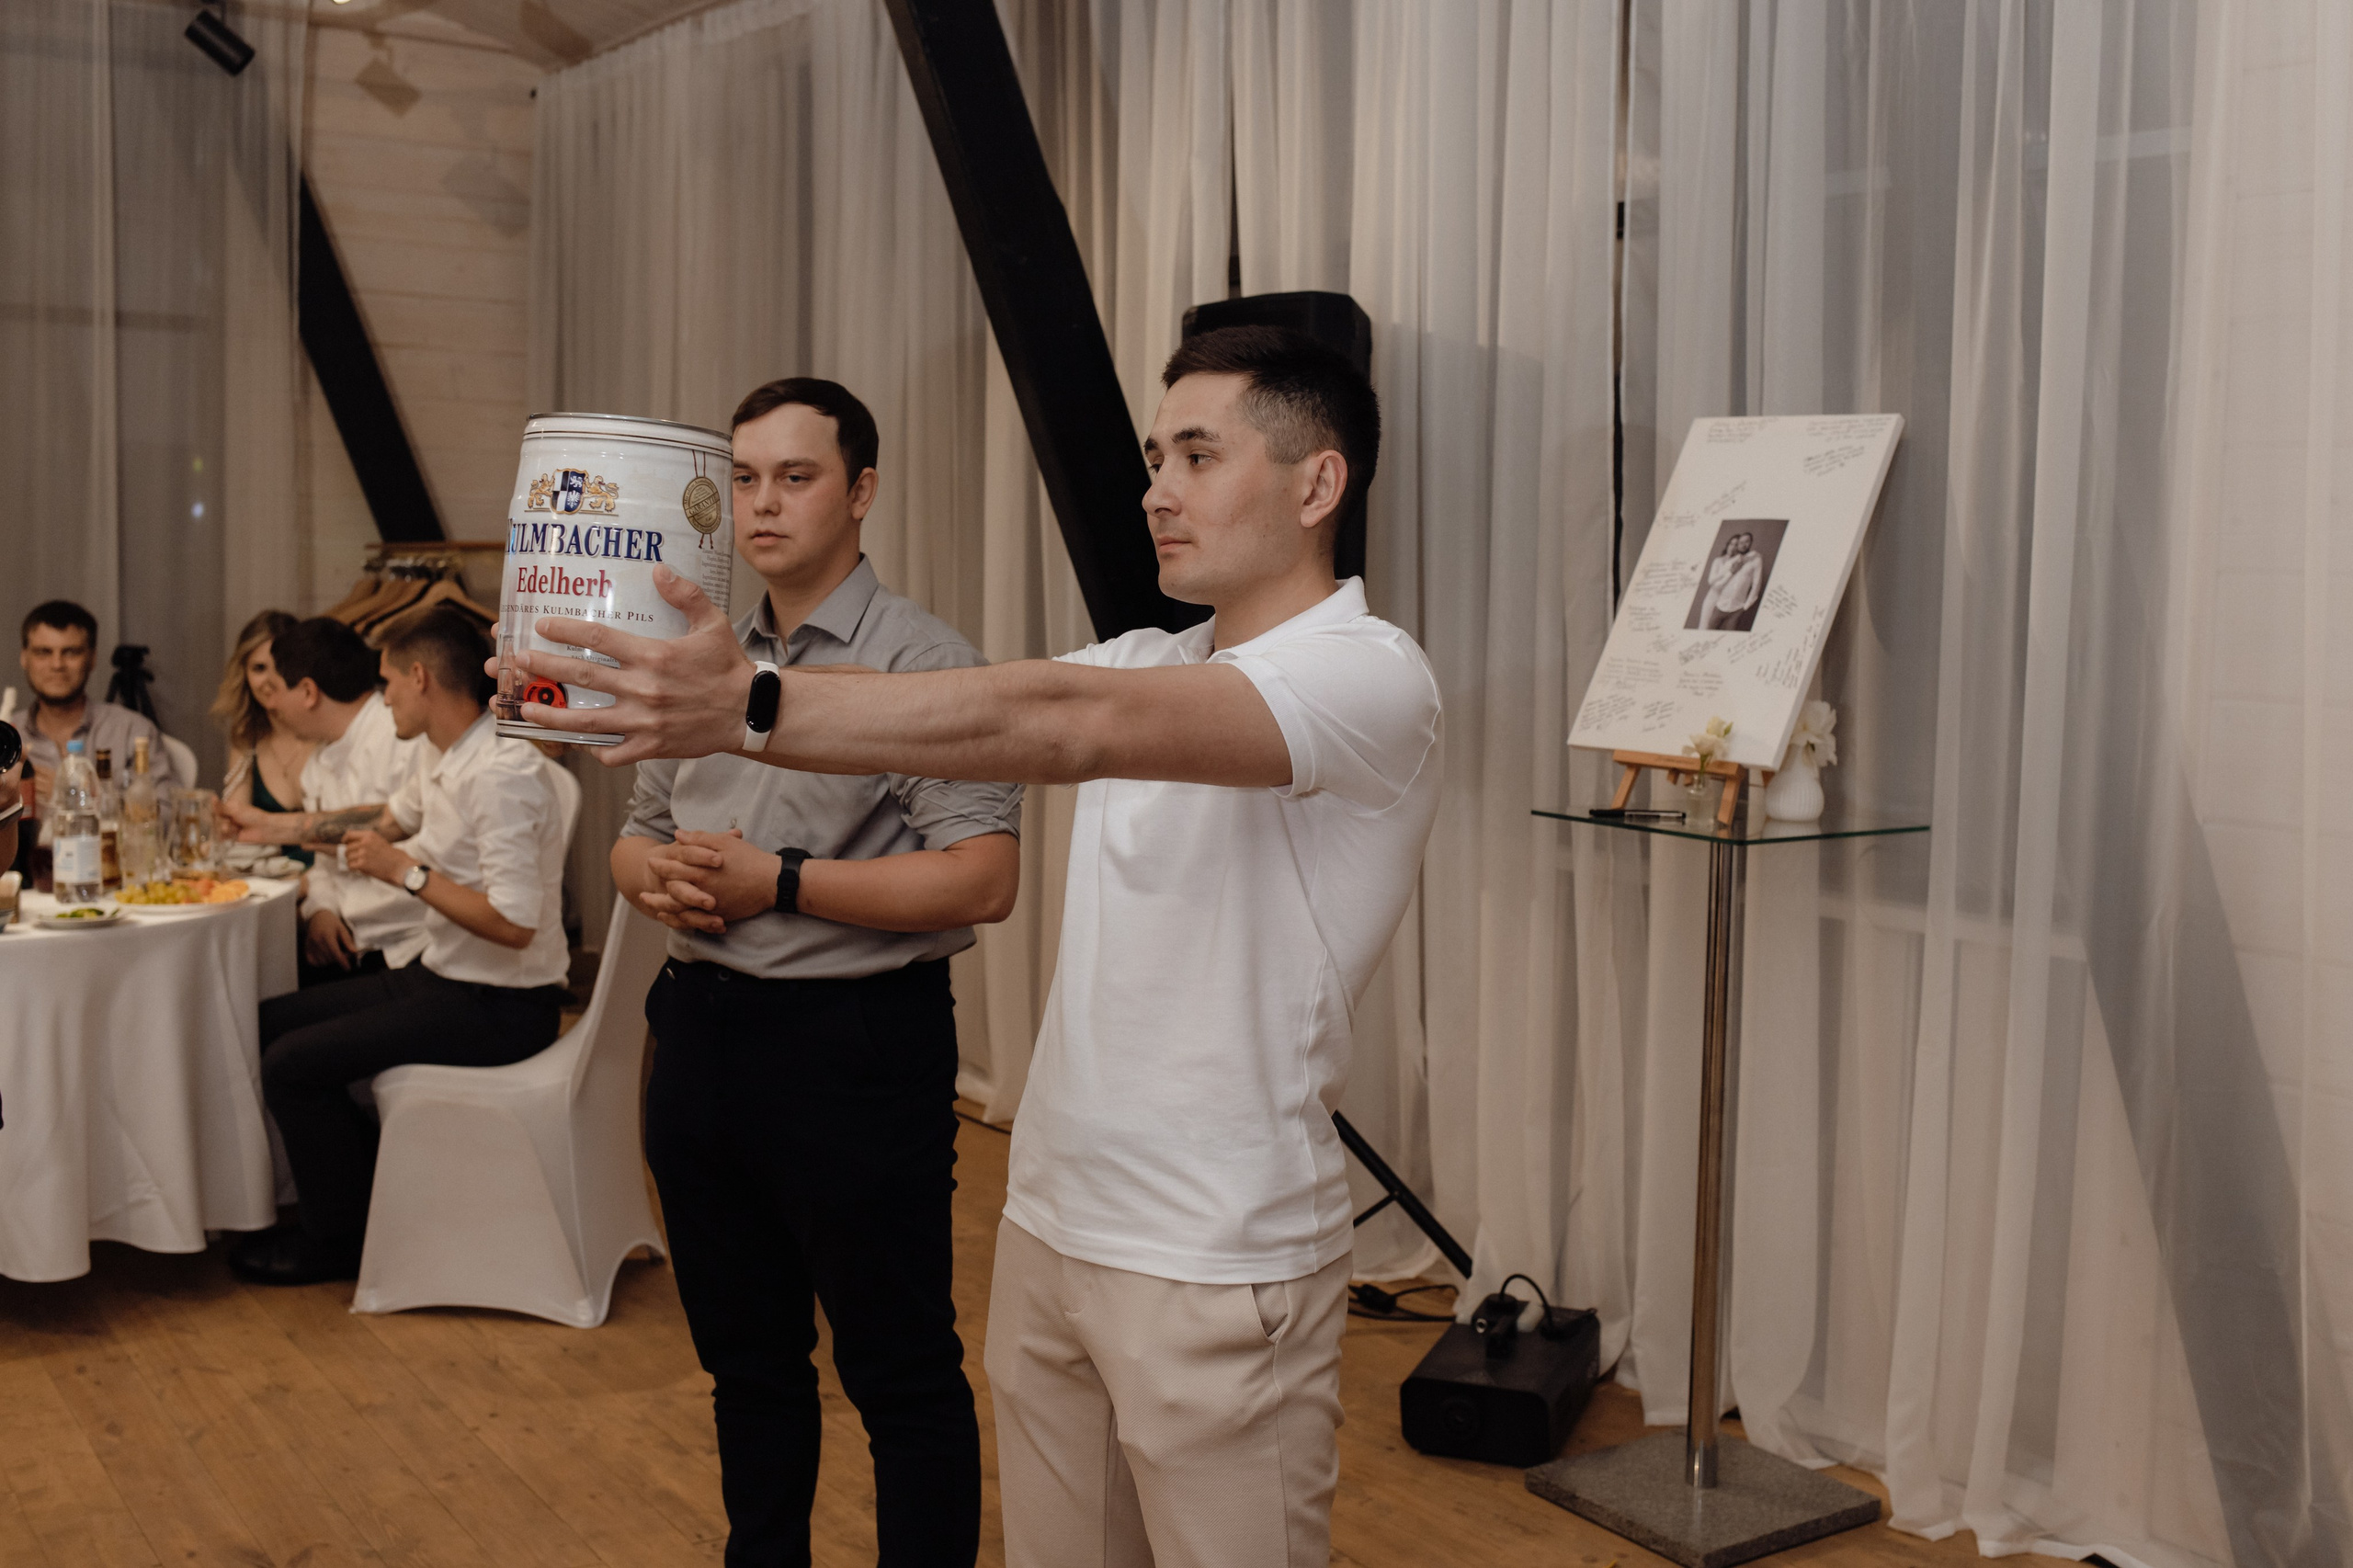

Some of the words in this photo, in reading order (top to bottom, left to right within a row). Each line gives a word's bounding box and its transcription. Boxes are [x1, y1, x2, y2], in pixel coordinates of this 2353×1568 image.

[517, 564, 613, 597] Edelherb
[543, 605, 621, 619] KULMBACHER
[627, 611, 654, 622] PILS
